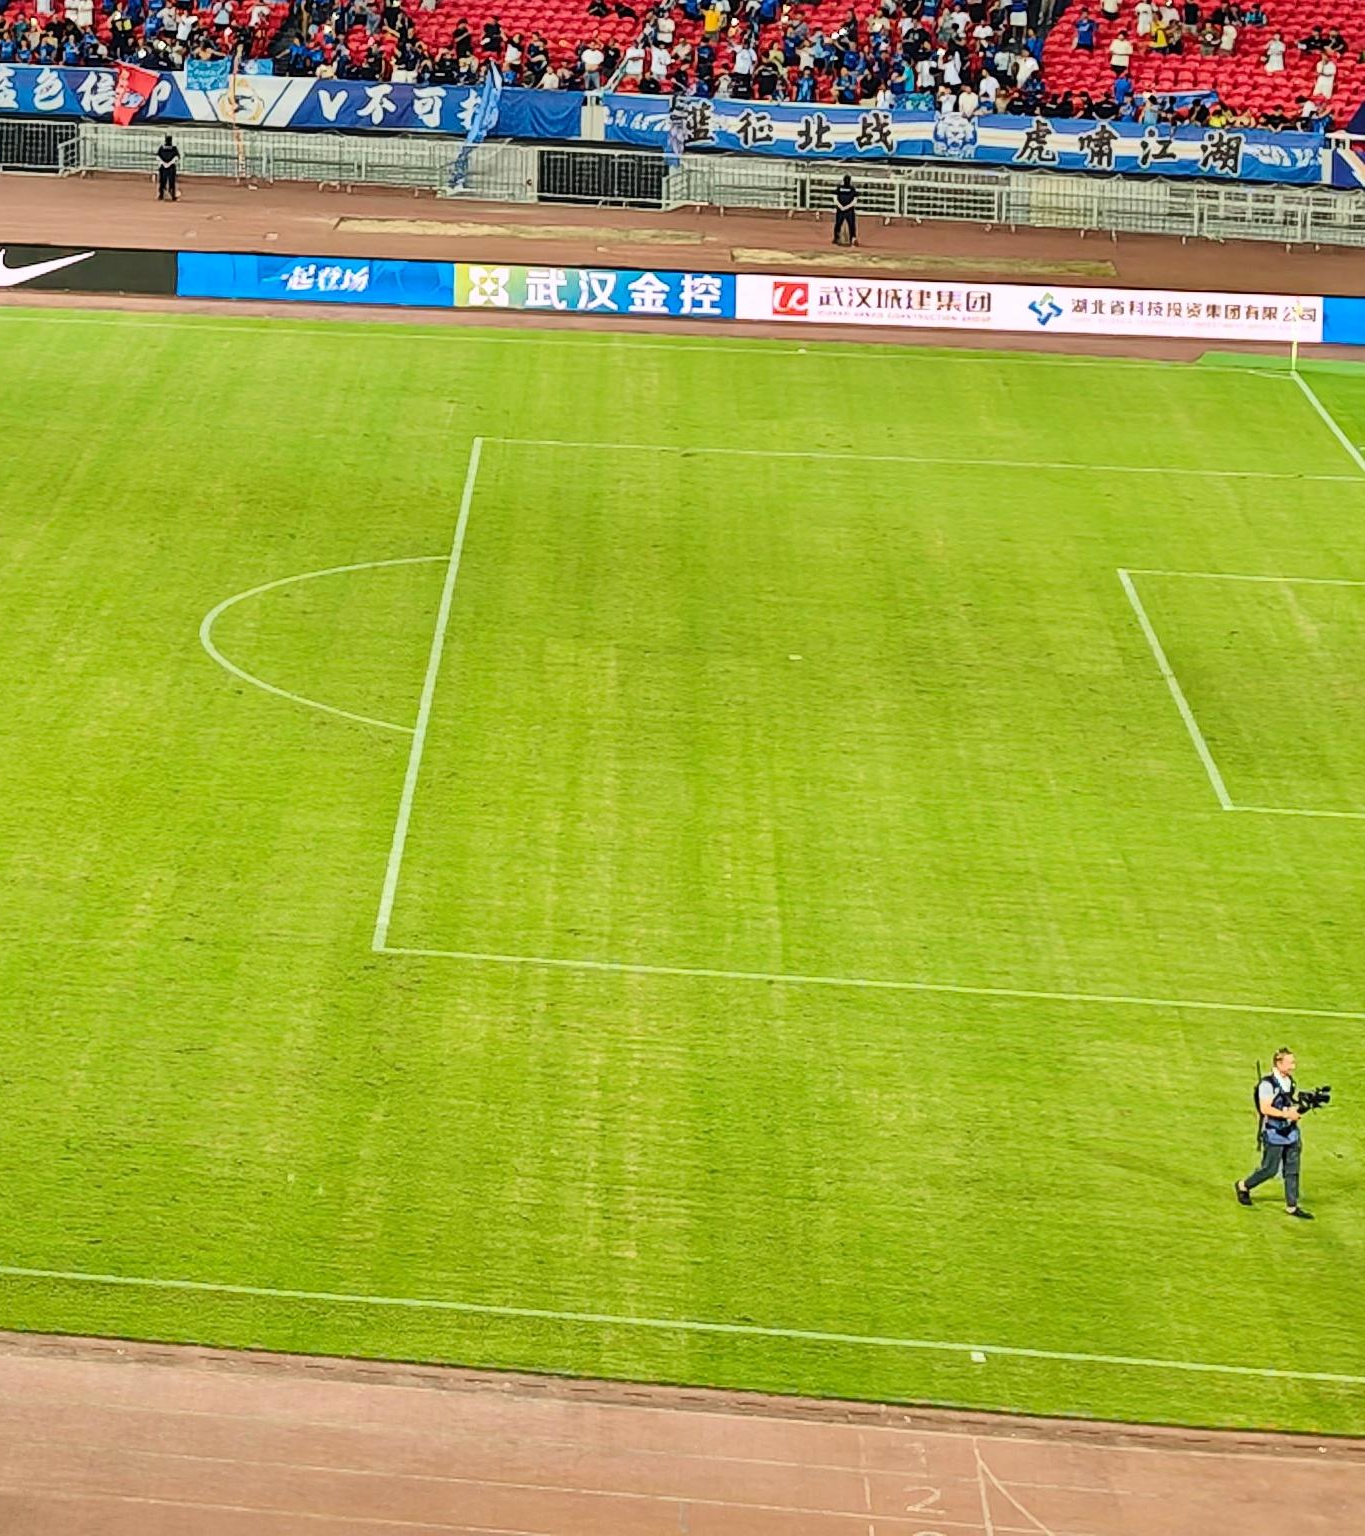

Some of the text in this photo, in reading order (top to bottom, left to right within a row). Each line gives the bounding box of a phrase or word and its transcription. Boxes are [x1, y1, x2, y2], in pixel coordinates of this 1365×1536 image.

[1015, 117, 1244, 177] 虎啸江湖
[524, 267, 723, 316] 武汉金控
[818, 285, 992, 314] 武汉城建集团
[1071, 297, 1317, 323] 湖北省科技投资集团有限公司
